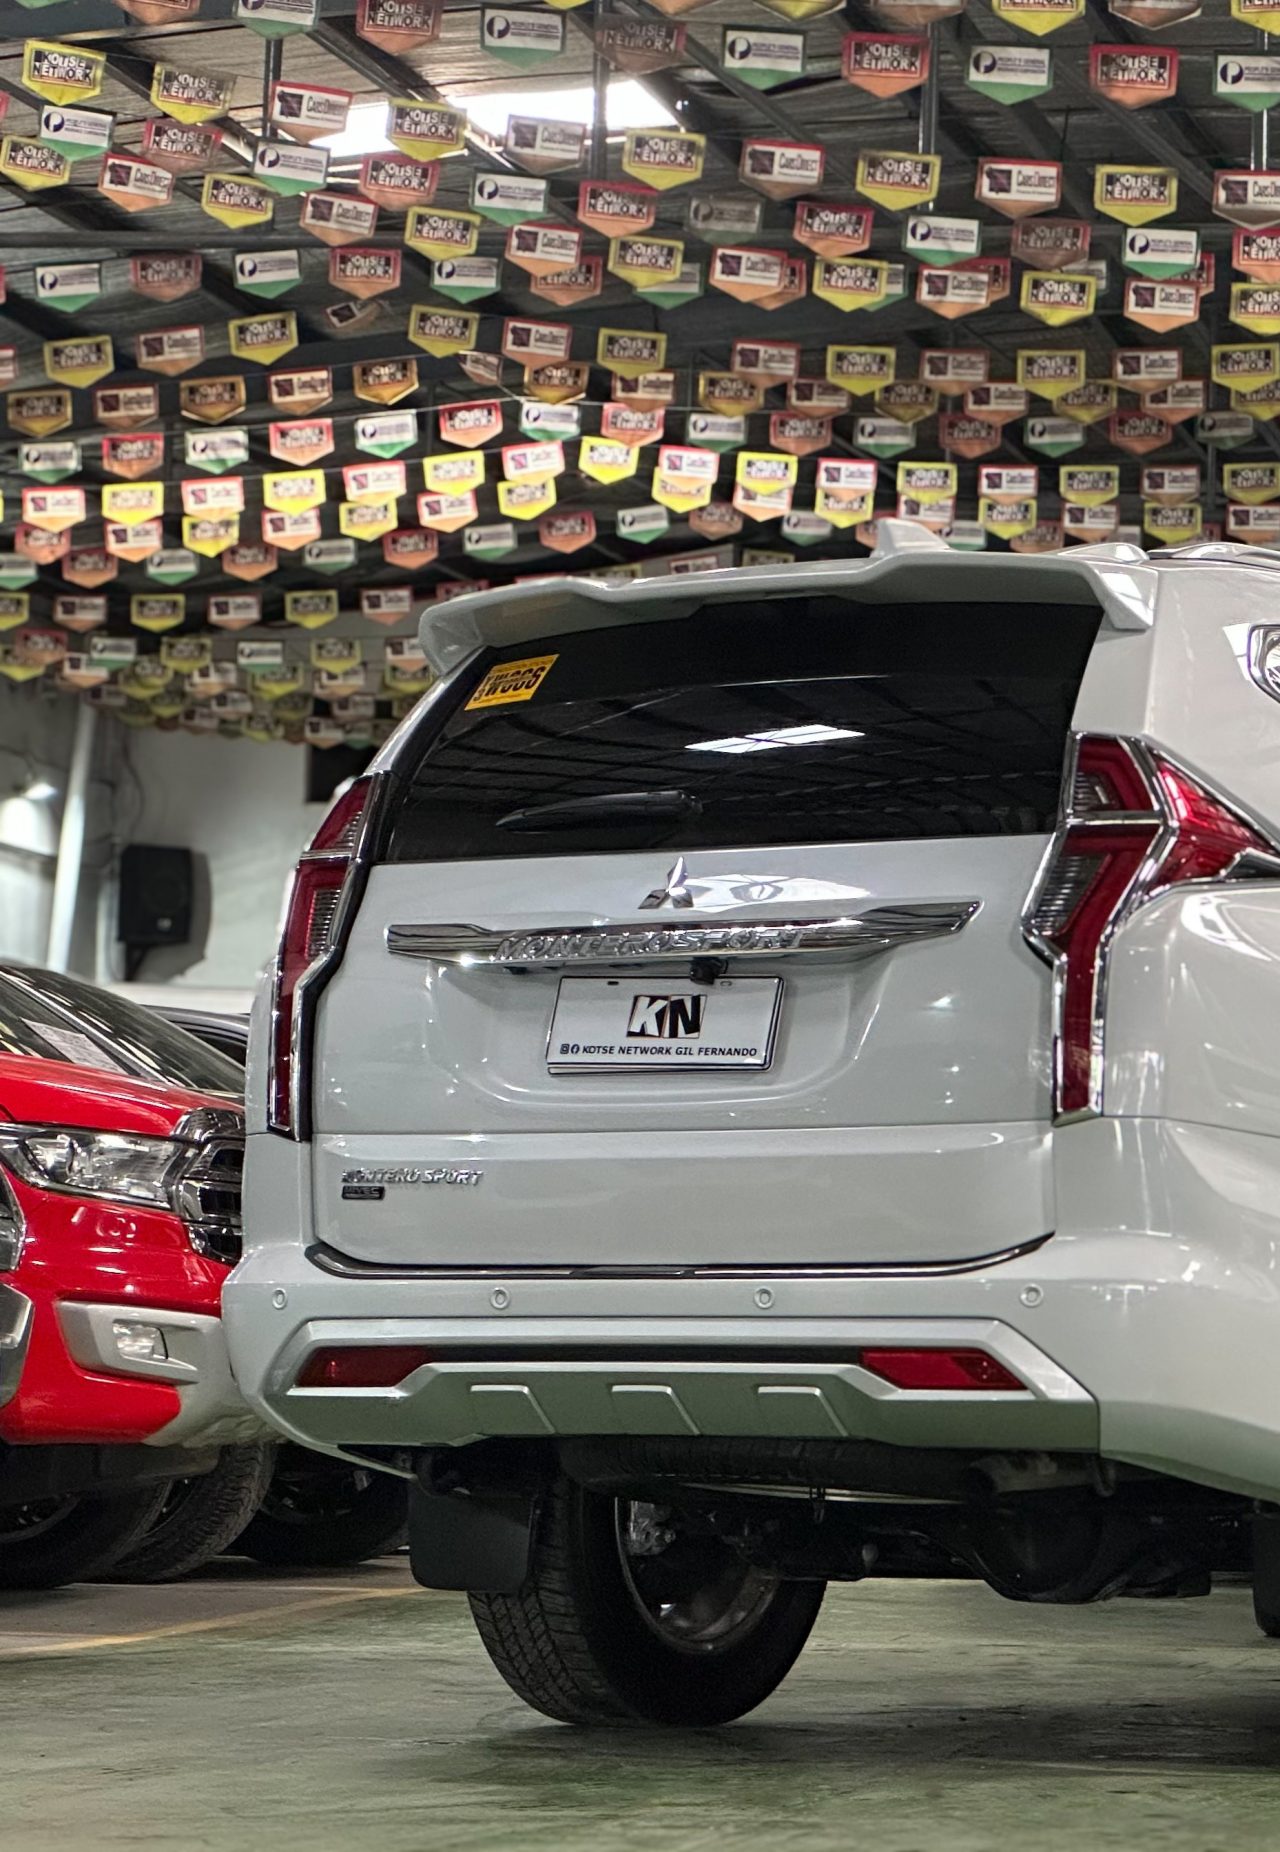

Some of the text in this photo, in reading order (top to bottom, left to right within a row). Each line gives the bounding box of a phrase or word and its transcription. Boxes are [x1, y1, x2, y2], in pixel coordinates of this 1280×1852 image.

[495, 930, 806, 959] MONTERO SPORT
[627, 994, 708, 1039] KN
[582, 1045, 758, 1057] KOTSE NETWORK GIL FERNANDO
[421, 1168, 485, 1186] SPORT
